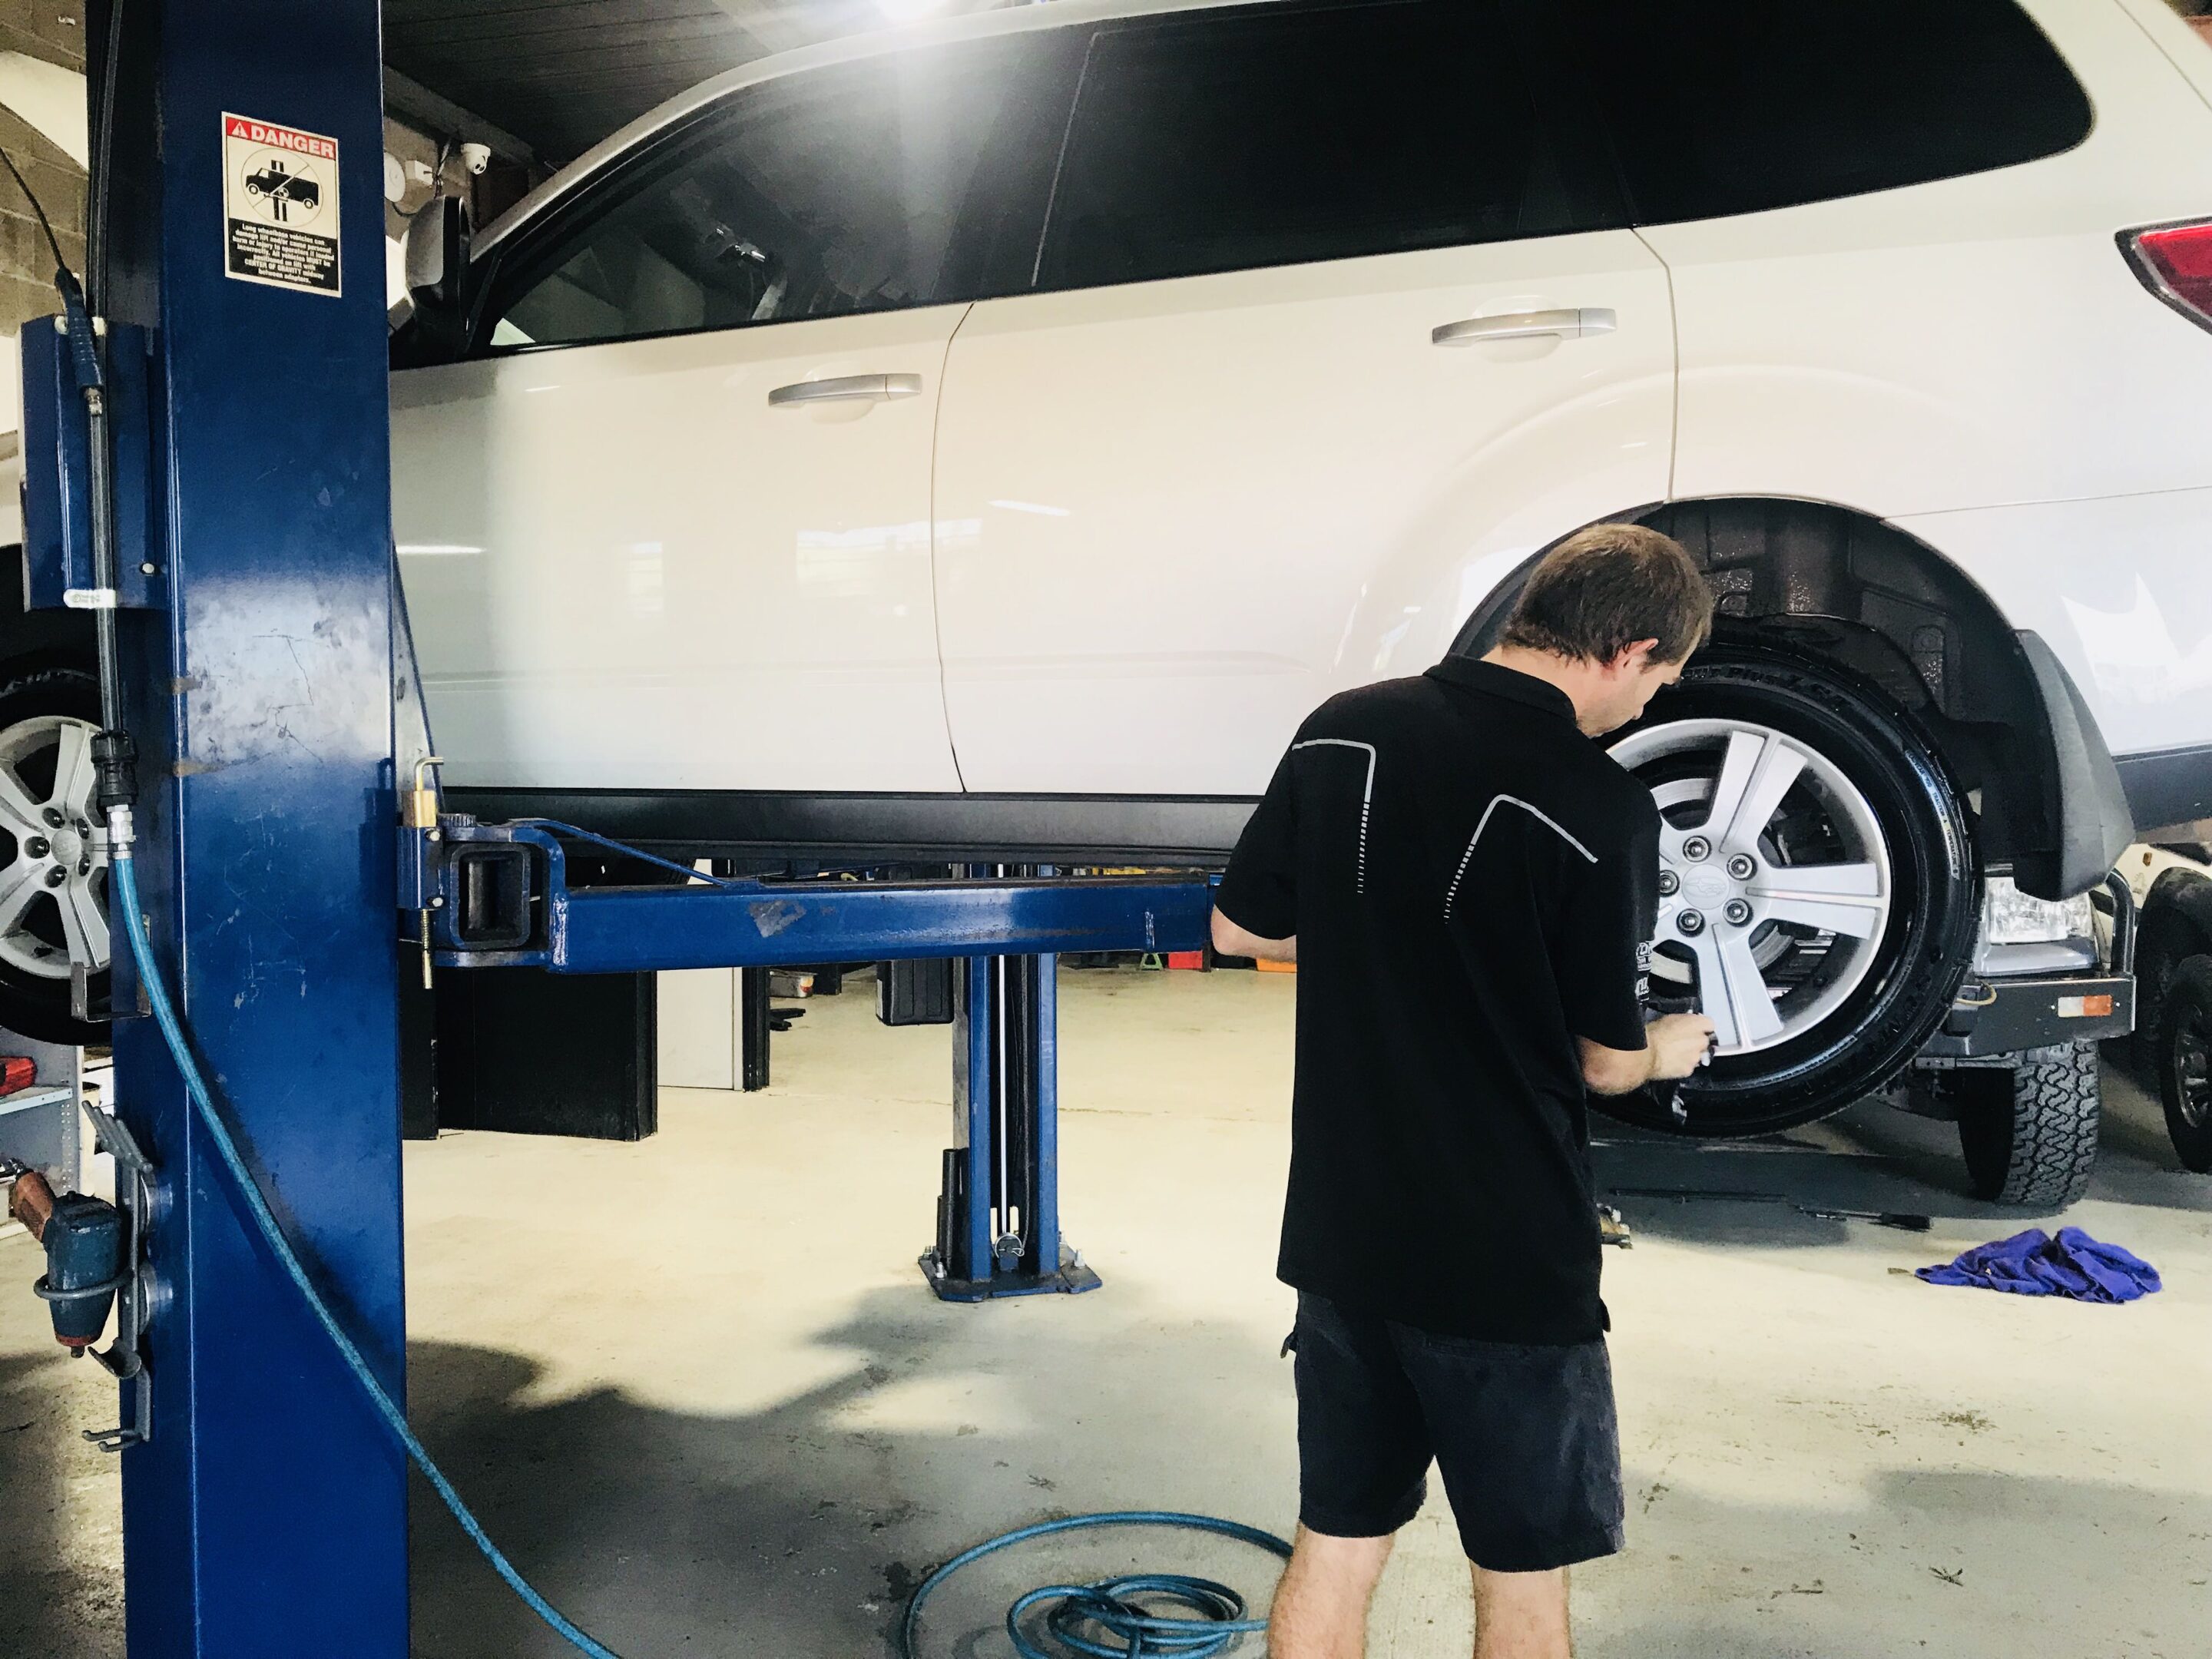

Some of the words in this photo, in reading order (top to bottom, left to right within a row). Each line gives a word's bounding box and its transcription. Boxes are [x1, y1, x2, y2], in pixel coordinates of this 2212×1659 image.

[252, 126, 334, 157] DANGER
[236, 230, 258, 239] damage
[270, 236, 287, 245] and/or
[308, 243, 331, 253] personal
[243, 224, 256, 233] Long
[258, 227, 288, 237] wheelbase
[290, 233, 313, 243] vehicles
[233, 236, 247, 244] harm
[257, 240, 273, 250] injury
[282, 245, 308, 256] operators
[316, 252, 334, 261] loaded
[253, 253, 283, 265] positioned
[282, 252, 305, 262] vehicles
[245, 258, 267, 268] CENTER
[277, 264, 301, 274] GRAVITY
[303, 270, 324, 279] midway
[259, 268, 283, 278] between
[1932, 792, 1946, 817] TRACTION
[1946, 829, 1958, 866] TEMPERATURE
